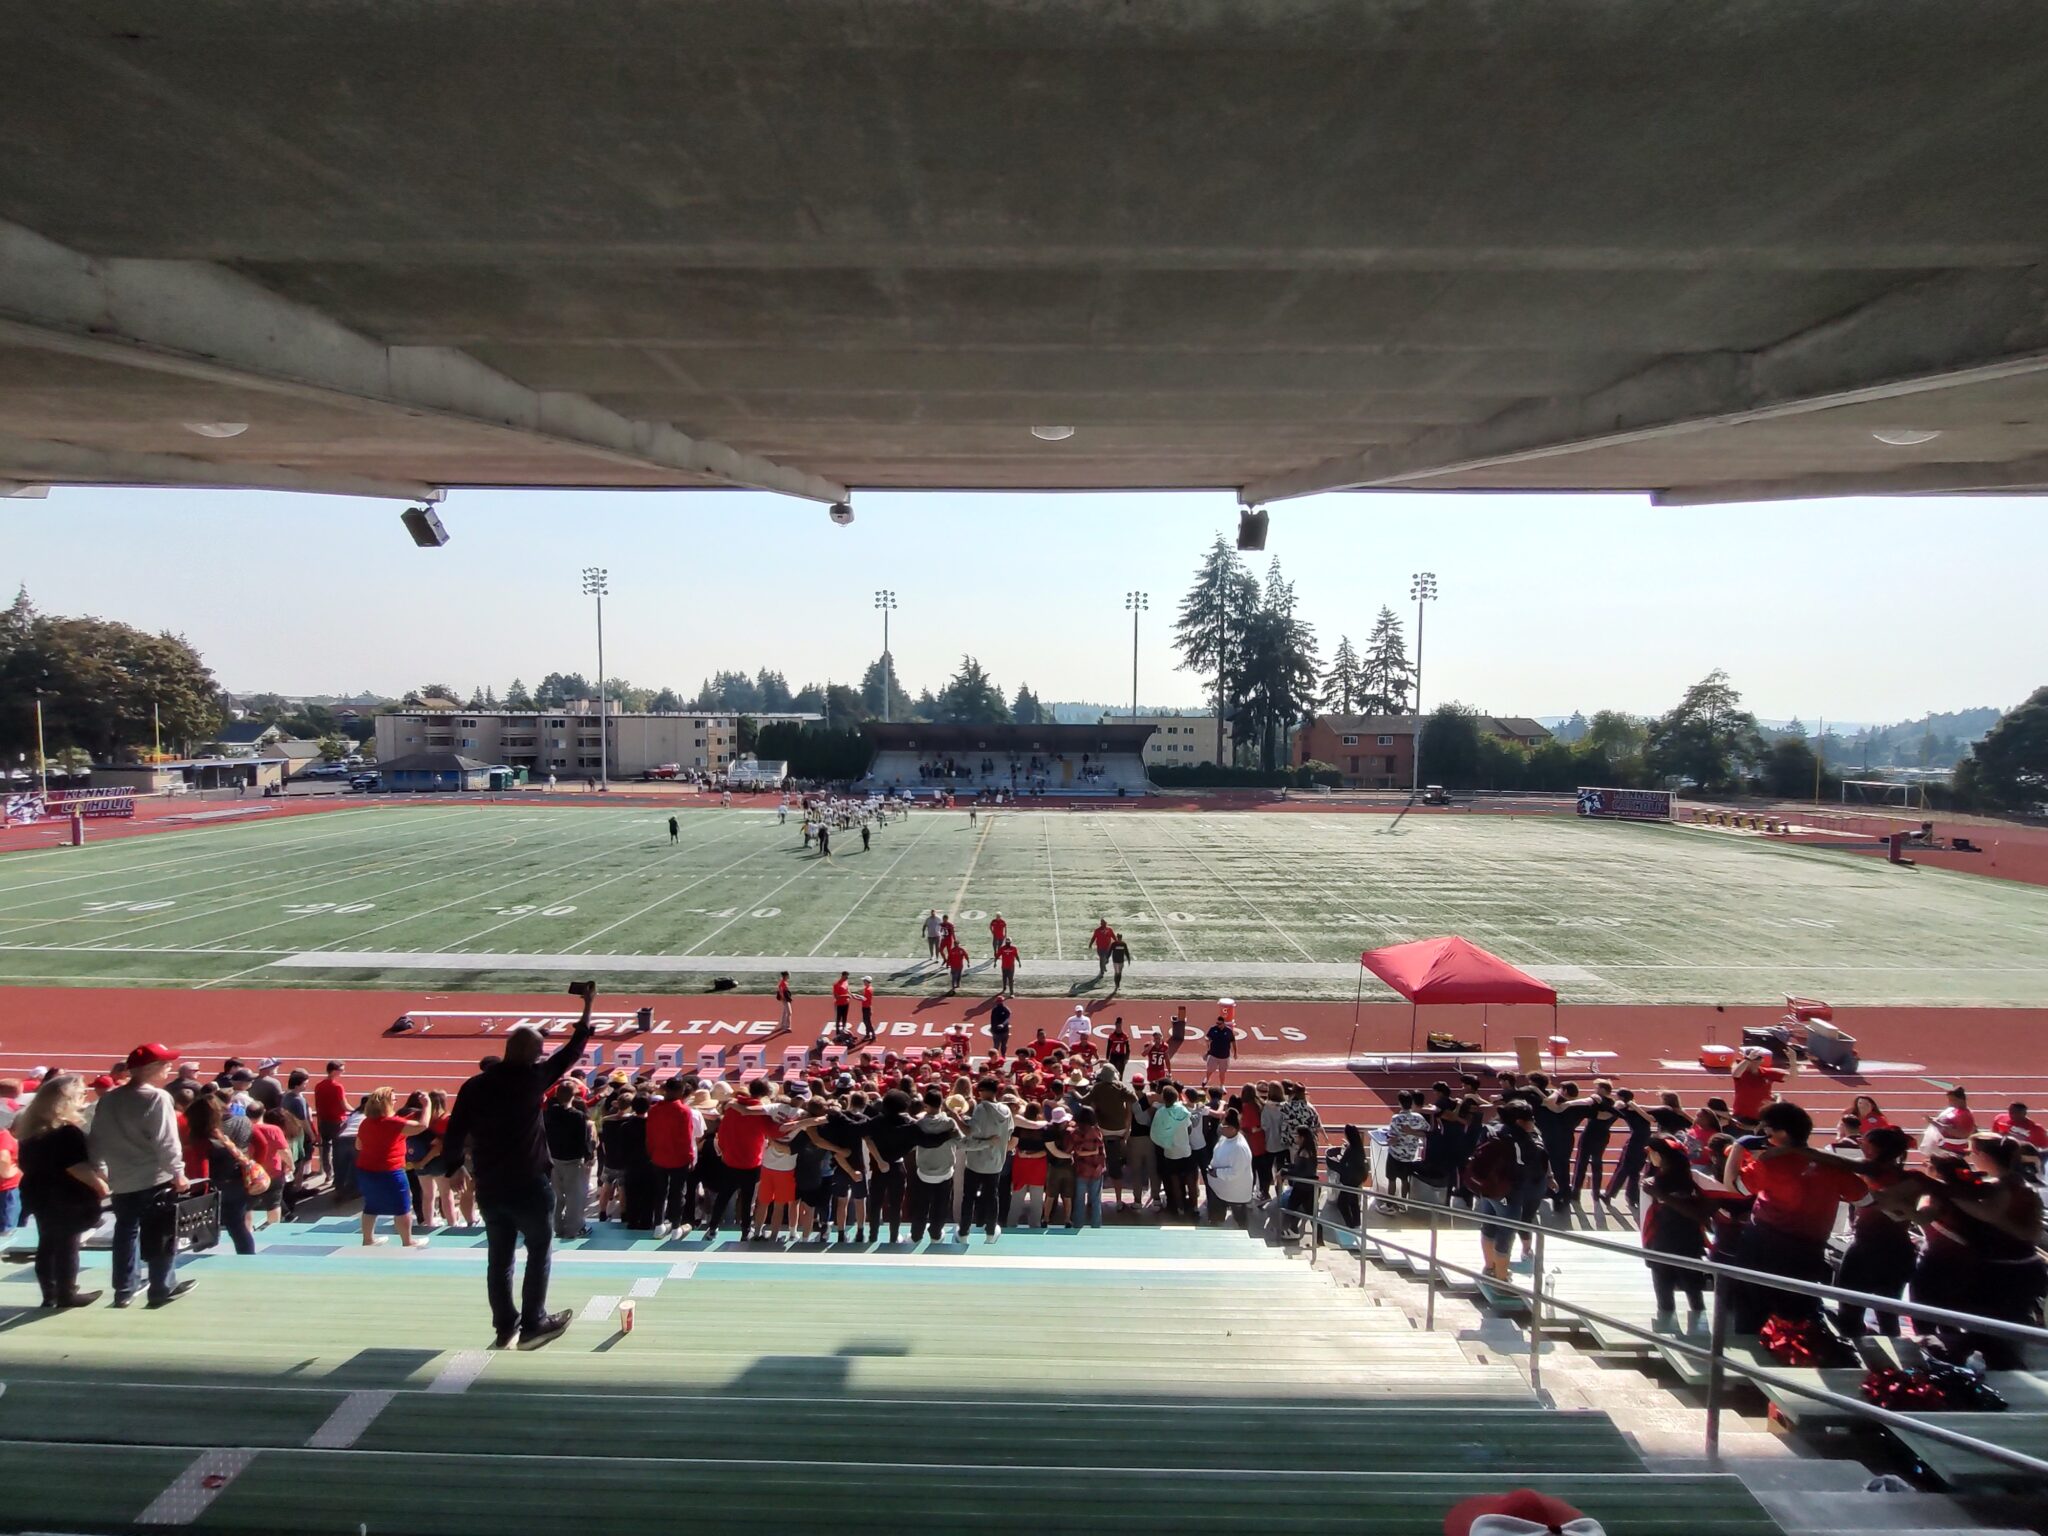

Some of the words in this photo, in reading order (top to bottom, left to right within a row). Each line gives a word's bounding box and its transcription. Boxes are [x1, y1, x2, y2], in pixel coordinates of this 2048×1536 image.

[64, 786, 135, 800] KENNEDY
[61, 798, 134, 813] CATHOLIC
[1060, 1023, 1308, 1041] CHOLS
[1151, 1053, 1165, 1066] 56
